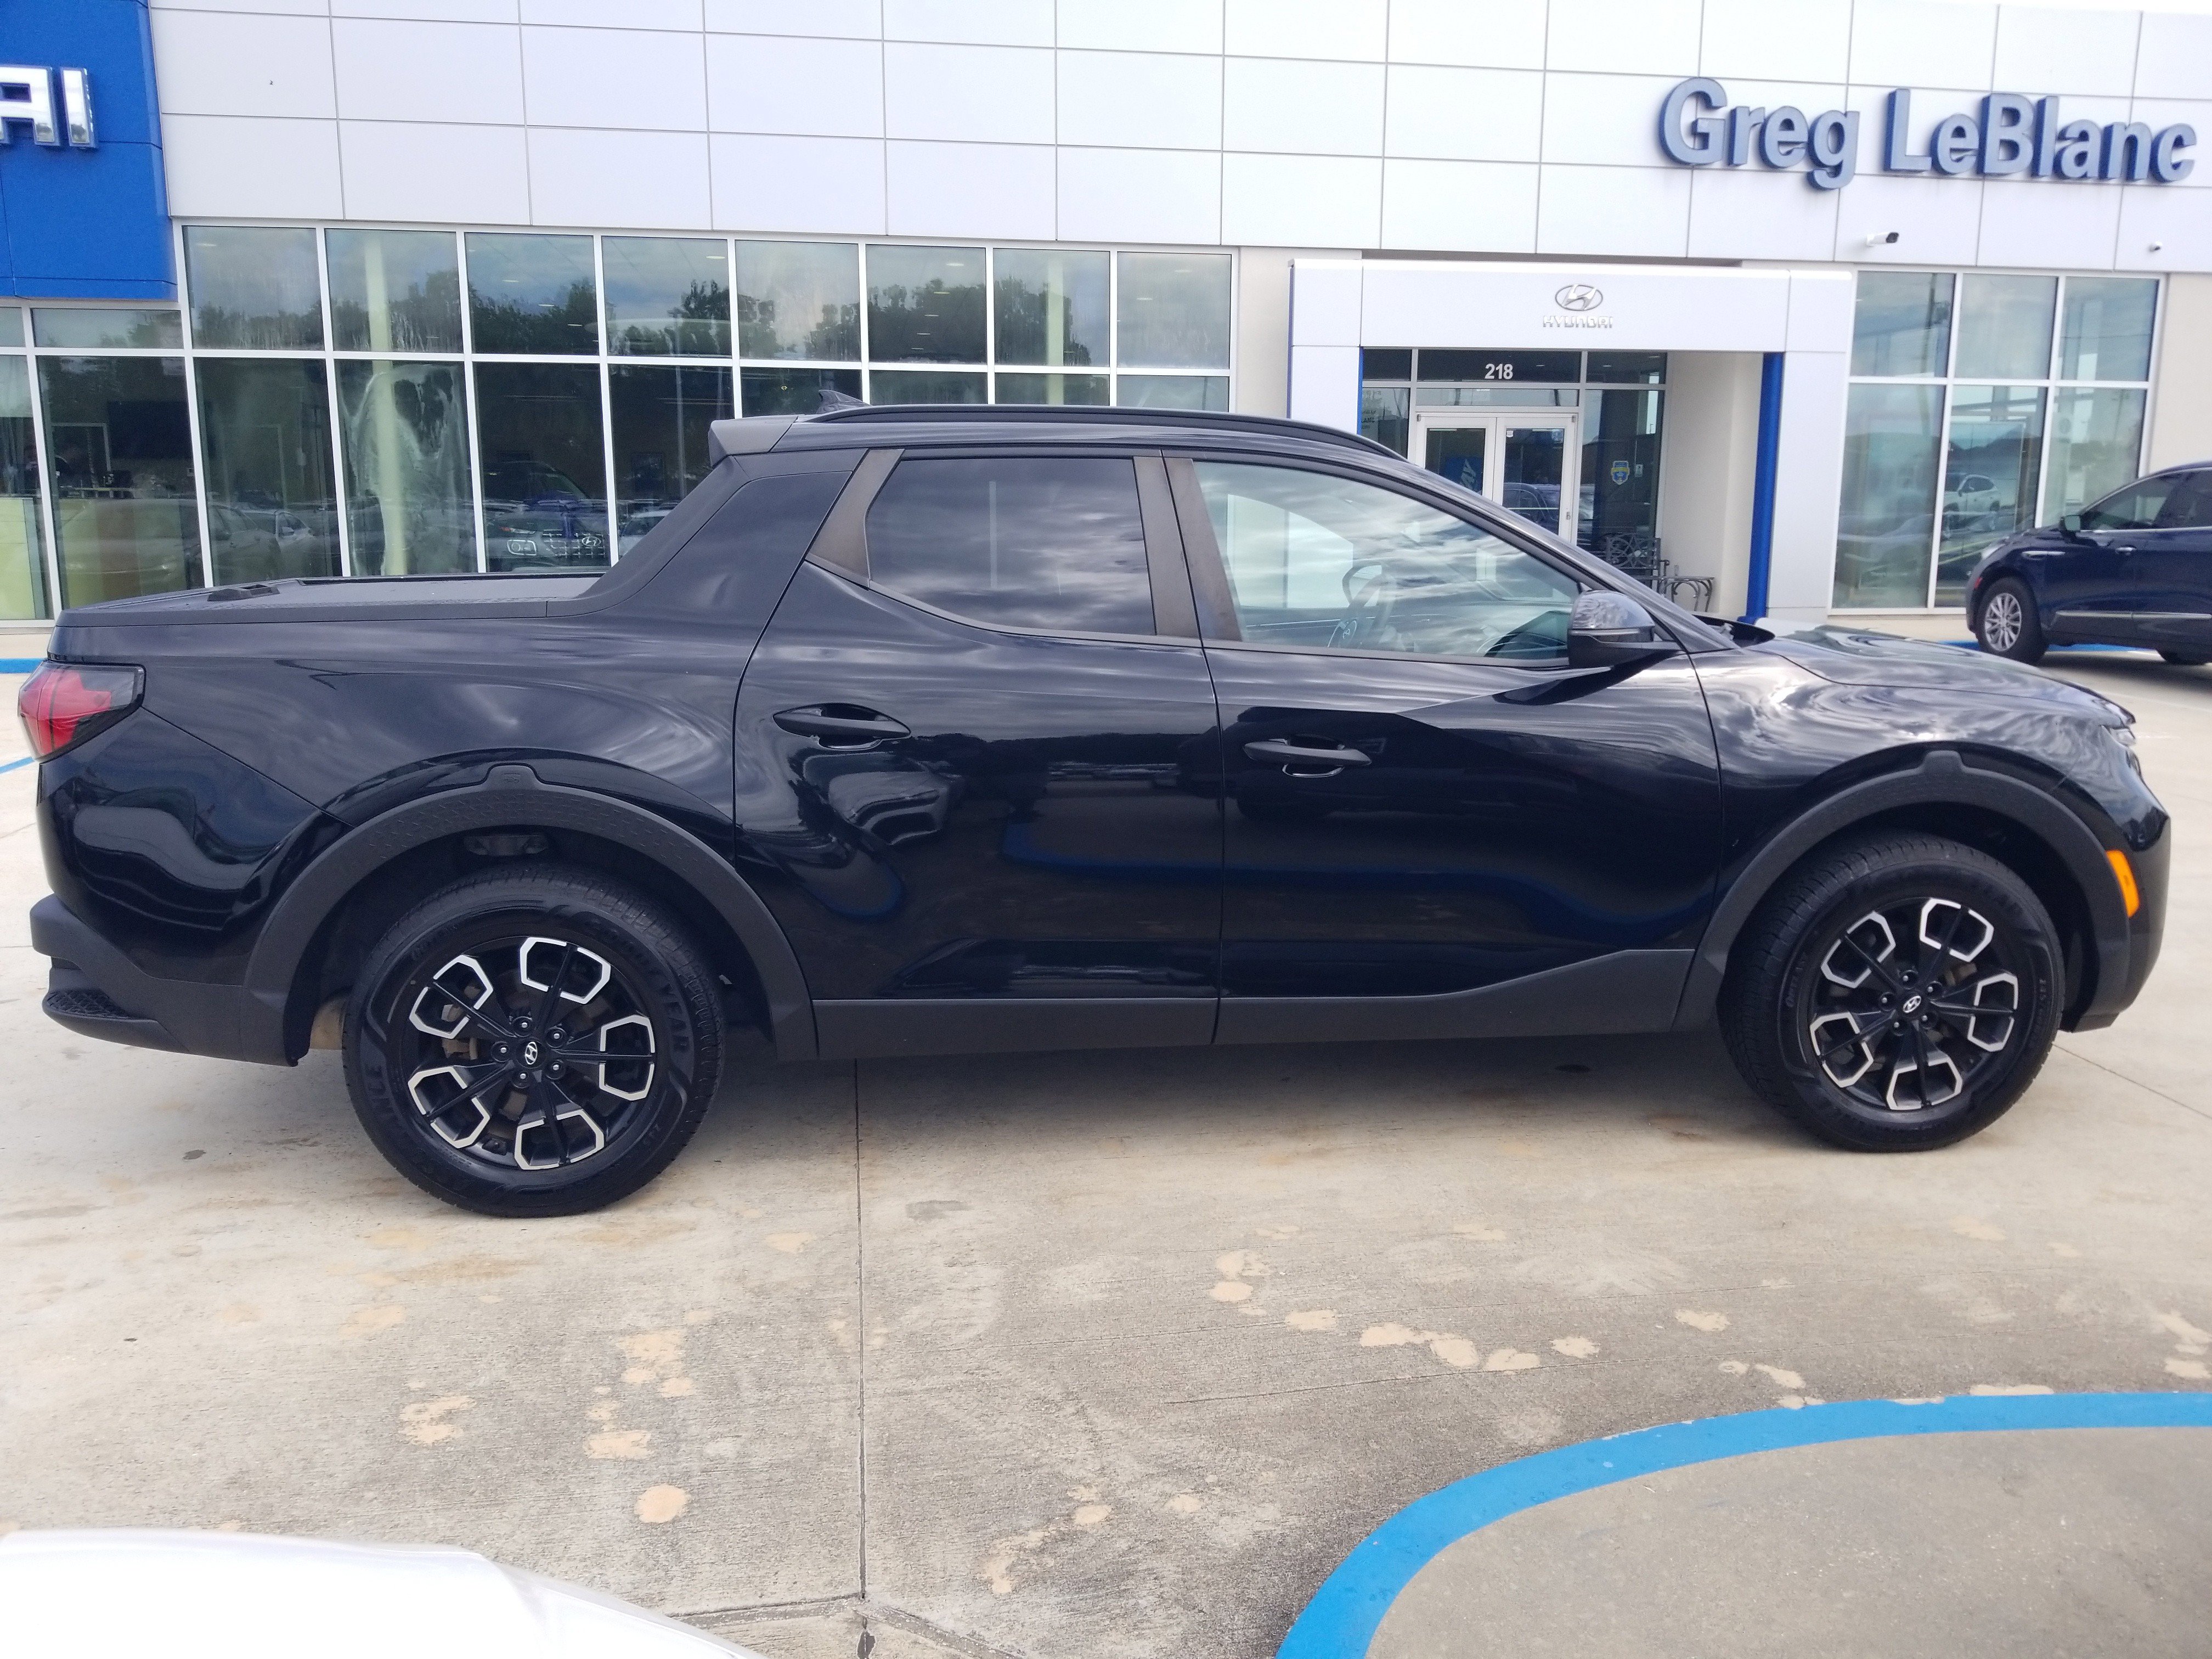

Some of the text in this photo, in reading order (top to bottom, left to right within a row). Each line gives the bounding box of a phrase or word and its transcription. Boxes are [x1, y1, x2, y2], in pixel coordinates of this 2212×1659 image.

[1658, 76, 2197, 190] Greg LeBlanc
[1543, 315, 1613, 329] HYUNDAI
[1485, 363, 1513, 380] 218
